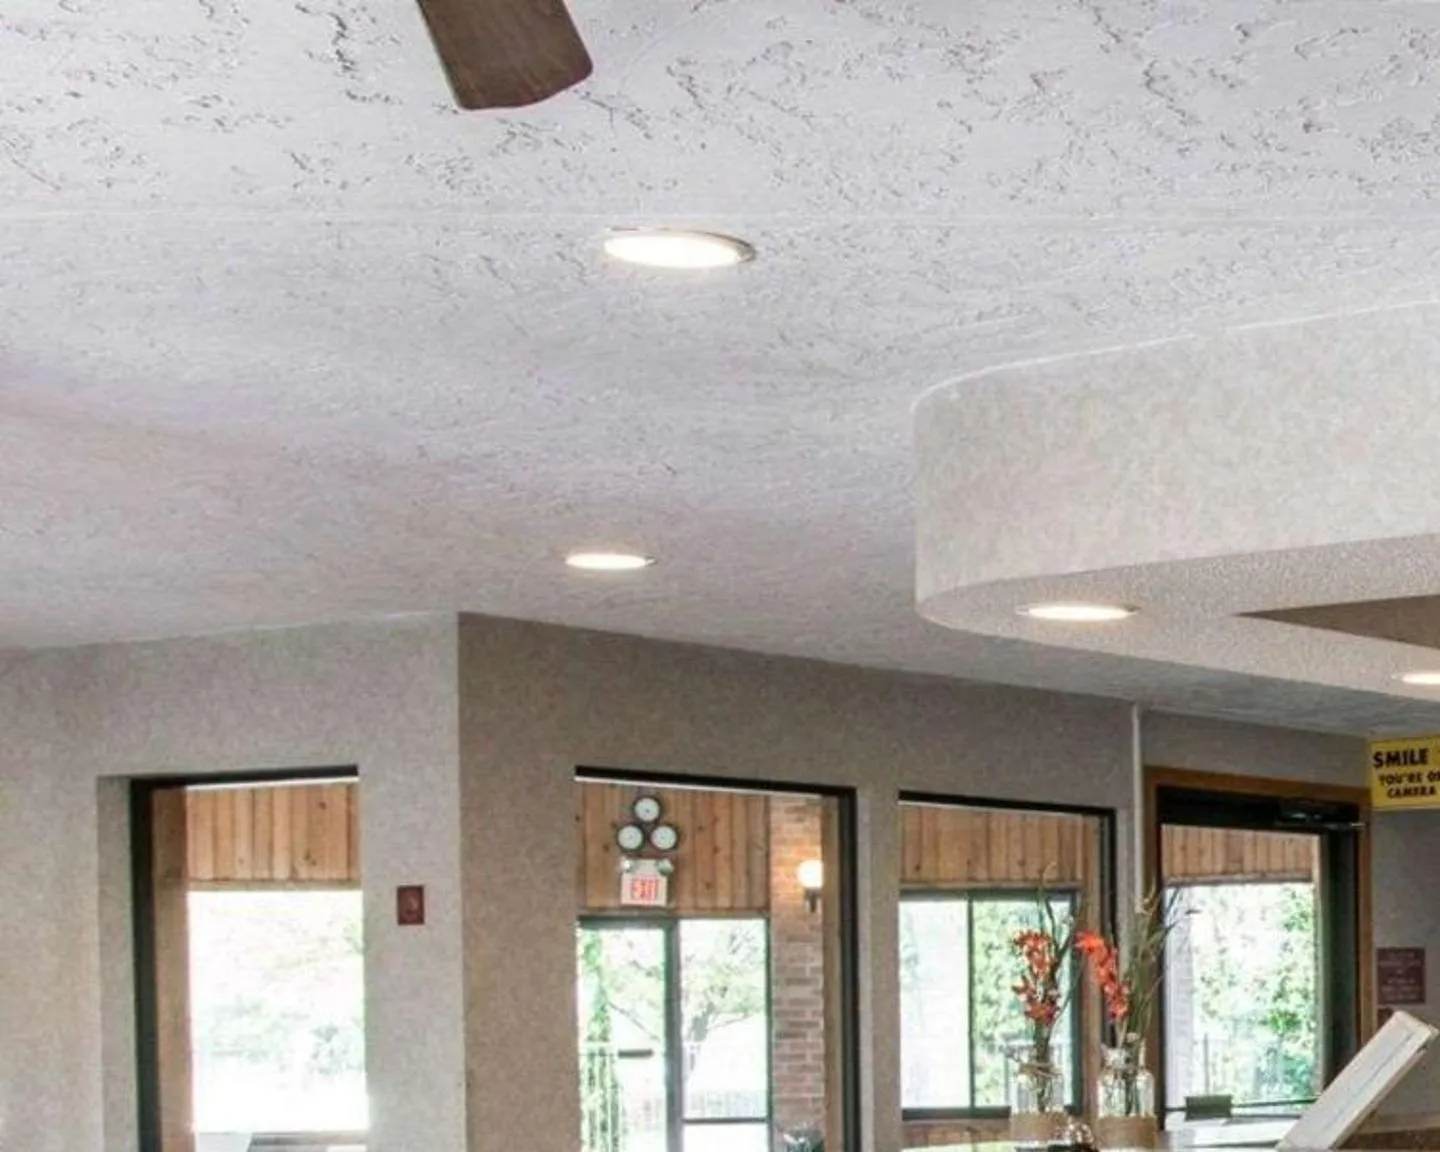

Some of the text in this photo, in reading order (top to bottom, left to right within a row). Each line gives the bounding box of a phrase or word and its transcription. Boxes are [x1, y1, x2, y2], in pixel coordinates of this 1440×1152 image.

[1373, 748, 1428, 769] SMILE
[1387, 786, 1437, 798] CAMERA
[631, 875, 659, 901] EXIT
